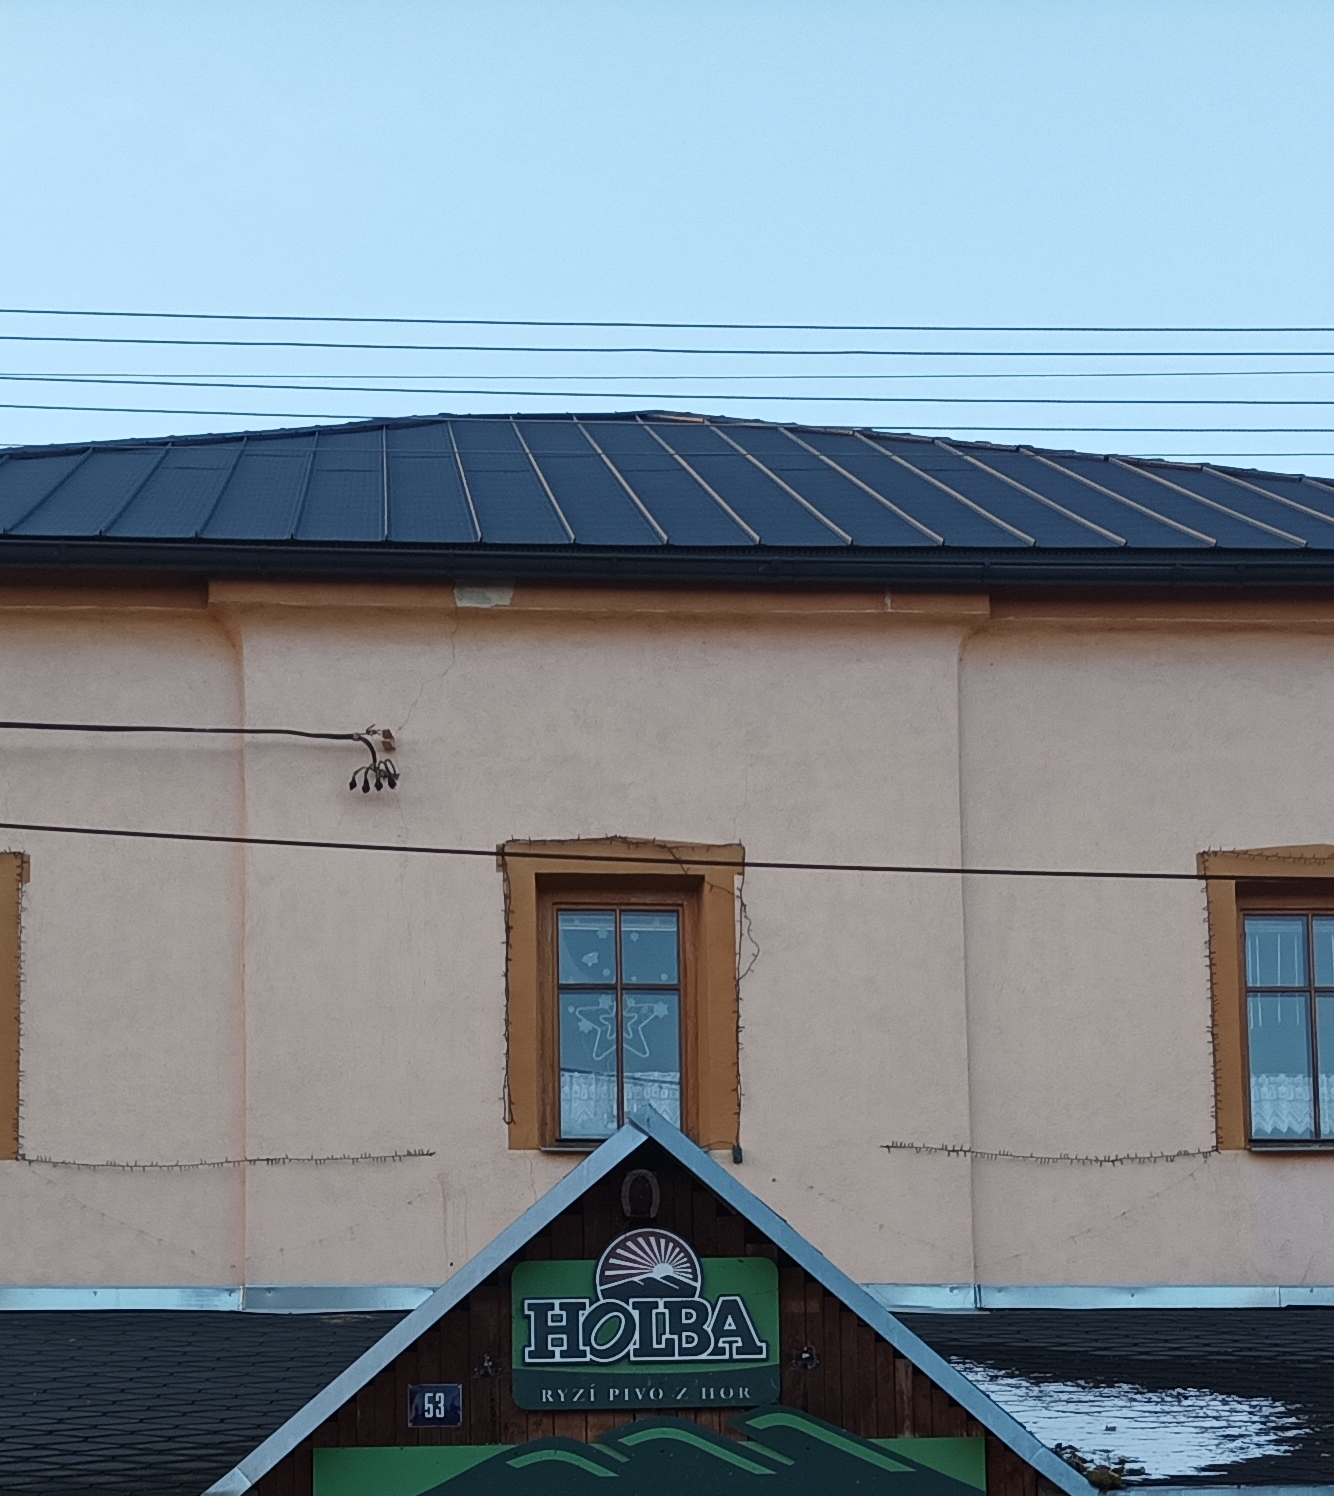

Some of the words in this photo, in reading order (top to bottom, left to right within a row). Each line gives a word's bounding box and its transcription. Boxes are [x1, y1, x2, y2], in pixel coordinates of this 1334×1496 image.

[524, 1296, 767, 1363] HOLBA
[424, 1392, 445, 1418] 53
[541, 1384, 596, 1402] RYZÍ
[609, 1387, 664, 1402] PIVO
[675, 1387, 688, 1400] Z
[701, 1386, 751, 1400] HOR
